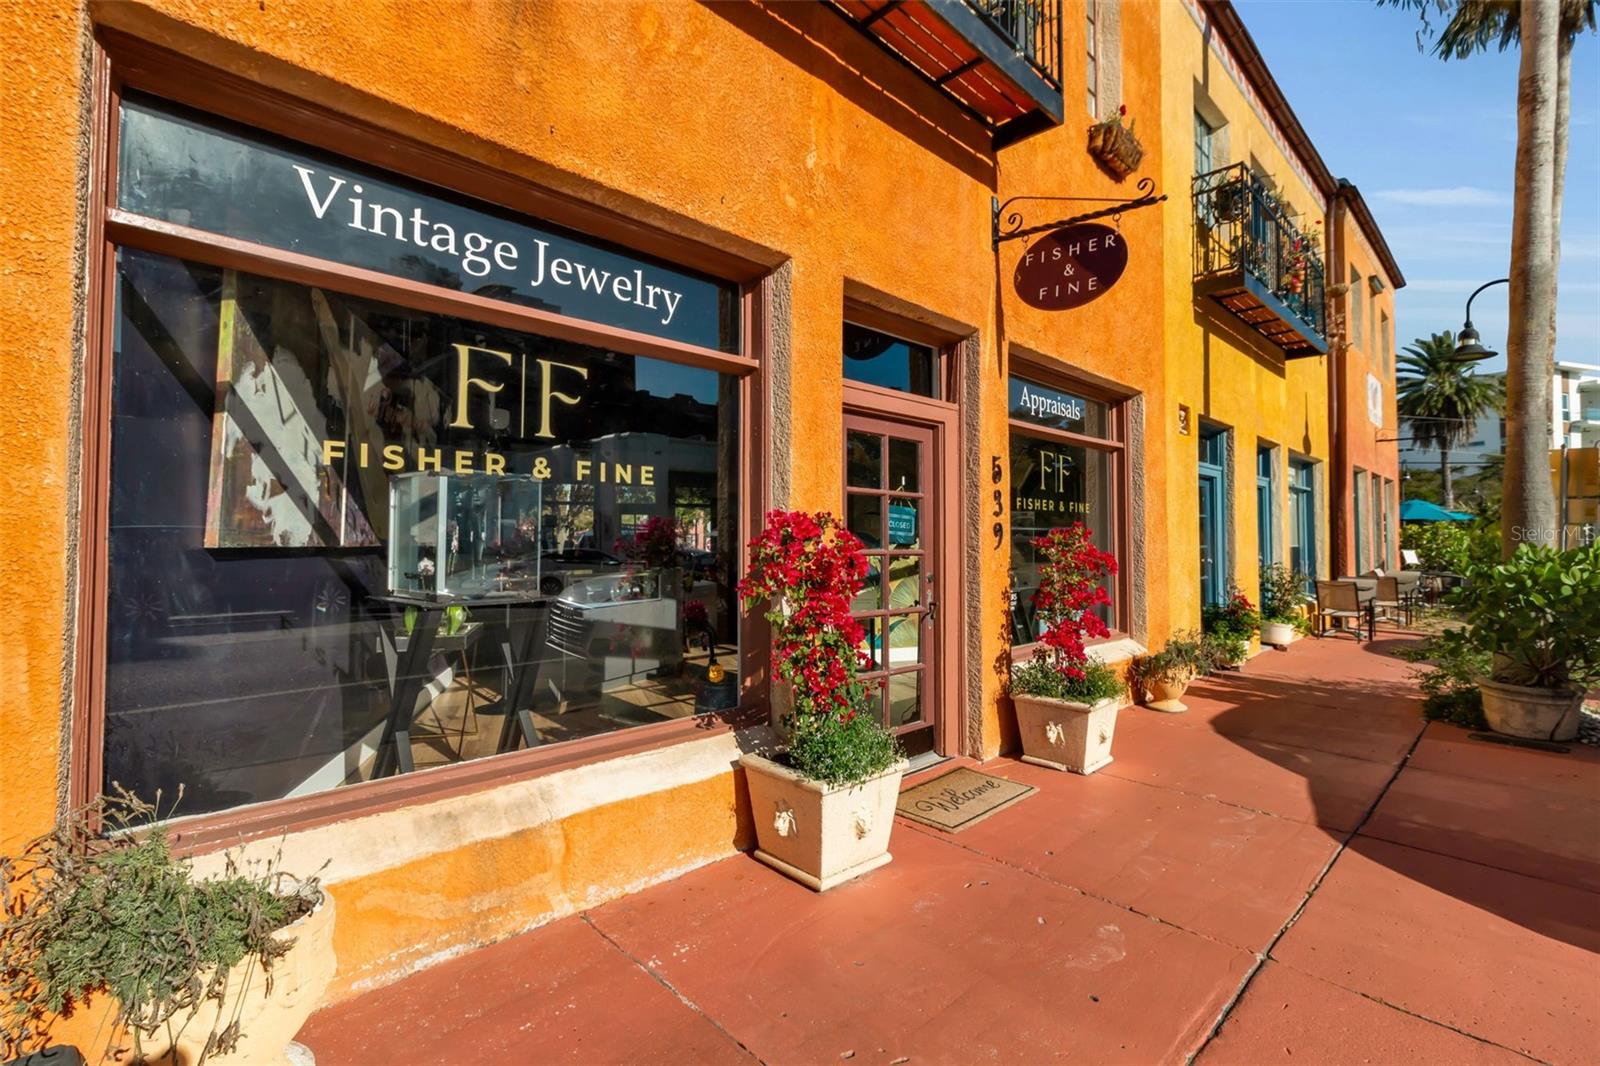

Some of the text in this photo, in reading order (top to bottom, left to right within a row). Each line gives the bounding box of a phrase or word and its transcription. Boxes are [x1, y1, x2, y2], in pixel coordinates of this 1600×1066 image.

[292, 164, 683, 325] Vintage Jewelry
[1025, 234, 1116, 267] FISHER
[1063, 263, 1075, 277] &
[1039, 277, 1097, 300] FINE
[1020, 385, 1081, 420] Appraisals
[322, 440, 655, 486] FISHER & FINE
[1016, 497, 1055, 511] FISHER
[1069, 502, 1091, 514] FINE
[915, 780, 1000, 813] Welcome
